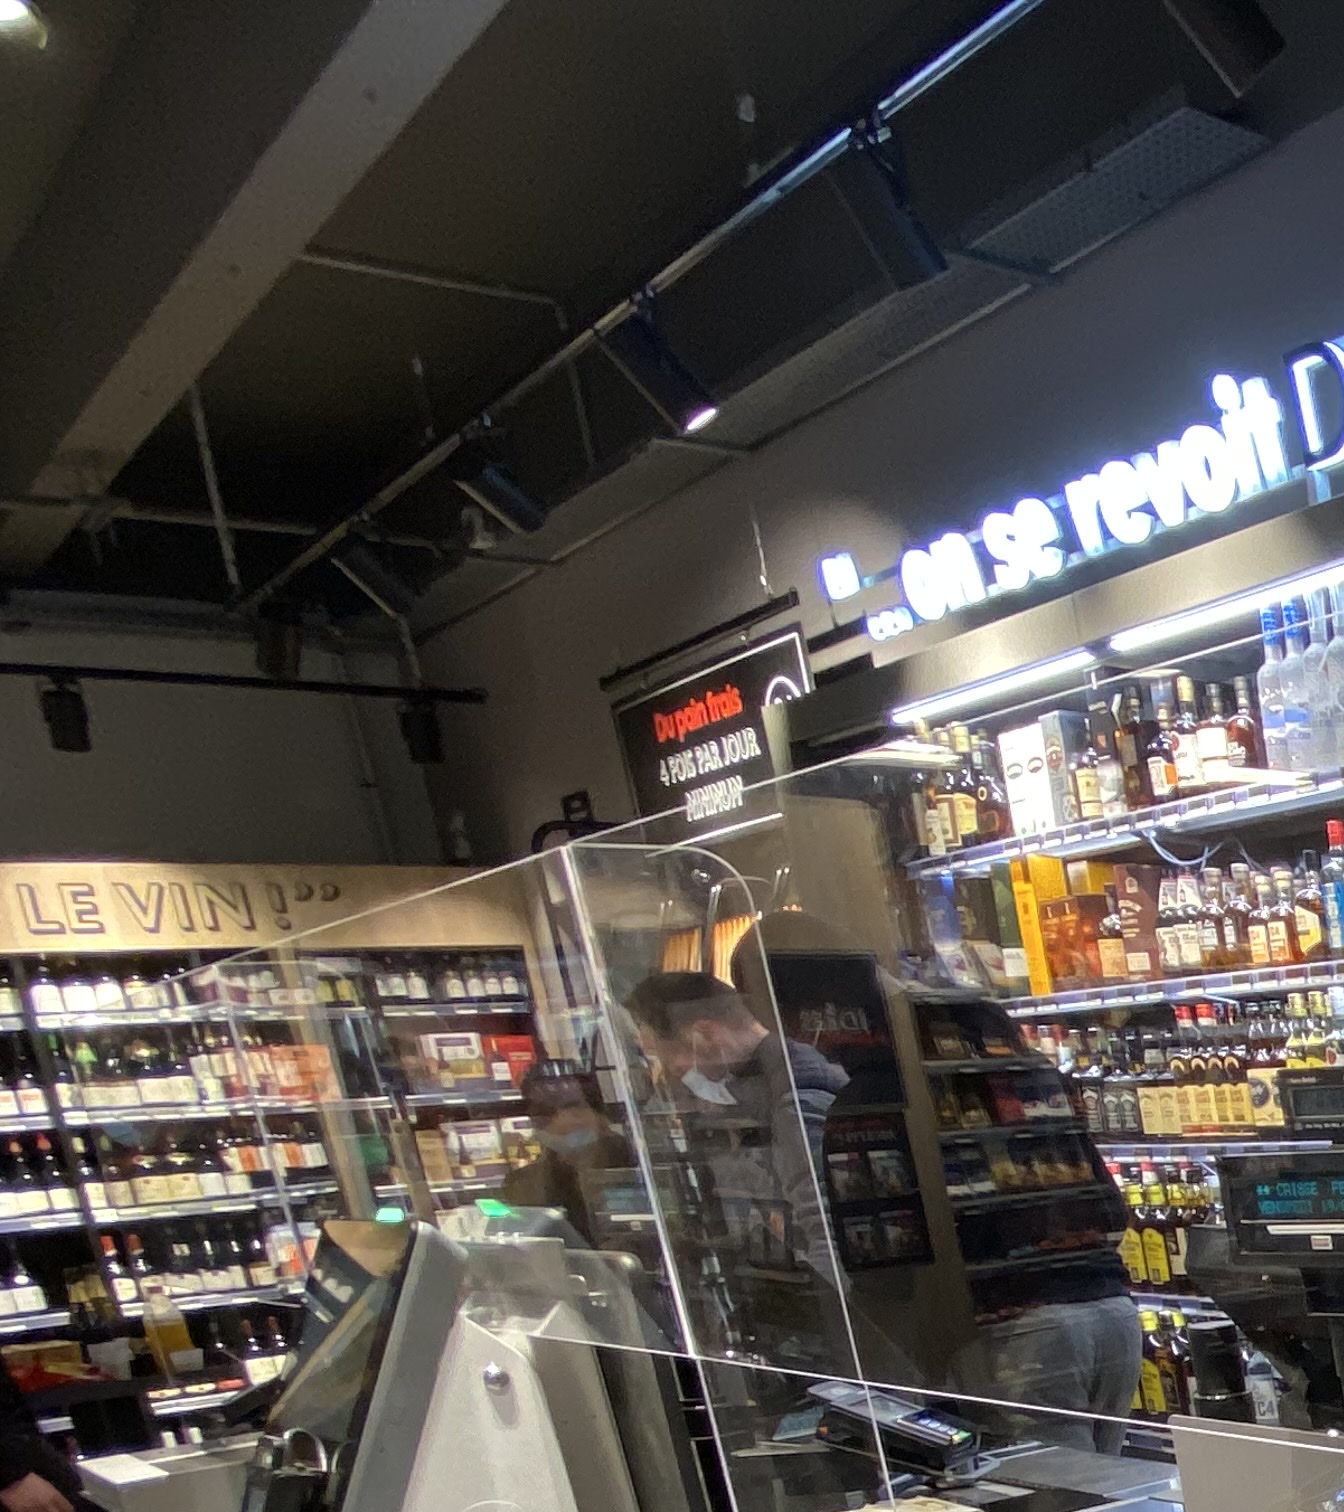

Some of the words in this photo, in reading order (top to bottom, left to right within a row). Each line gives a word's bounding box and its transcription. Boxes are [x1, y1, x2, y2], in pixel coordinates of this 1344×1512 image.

[983, 498, 1066, 590] se
[1064, 373, 1291, 559] revoit
[653, 711, 677, 743] Du
[675, 698, 710, 743] pain
[706, 684, 744, 723] frais
[659, 758, 671, 787] 4
[667, 748, 698, 784] FOIS
[693, 741, 725, 774] PAR
[720, 727, 762, 766] JOUR
[18, 883, 105, 935] LE
[111, 883, 260, 932] VIN
